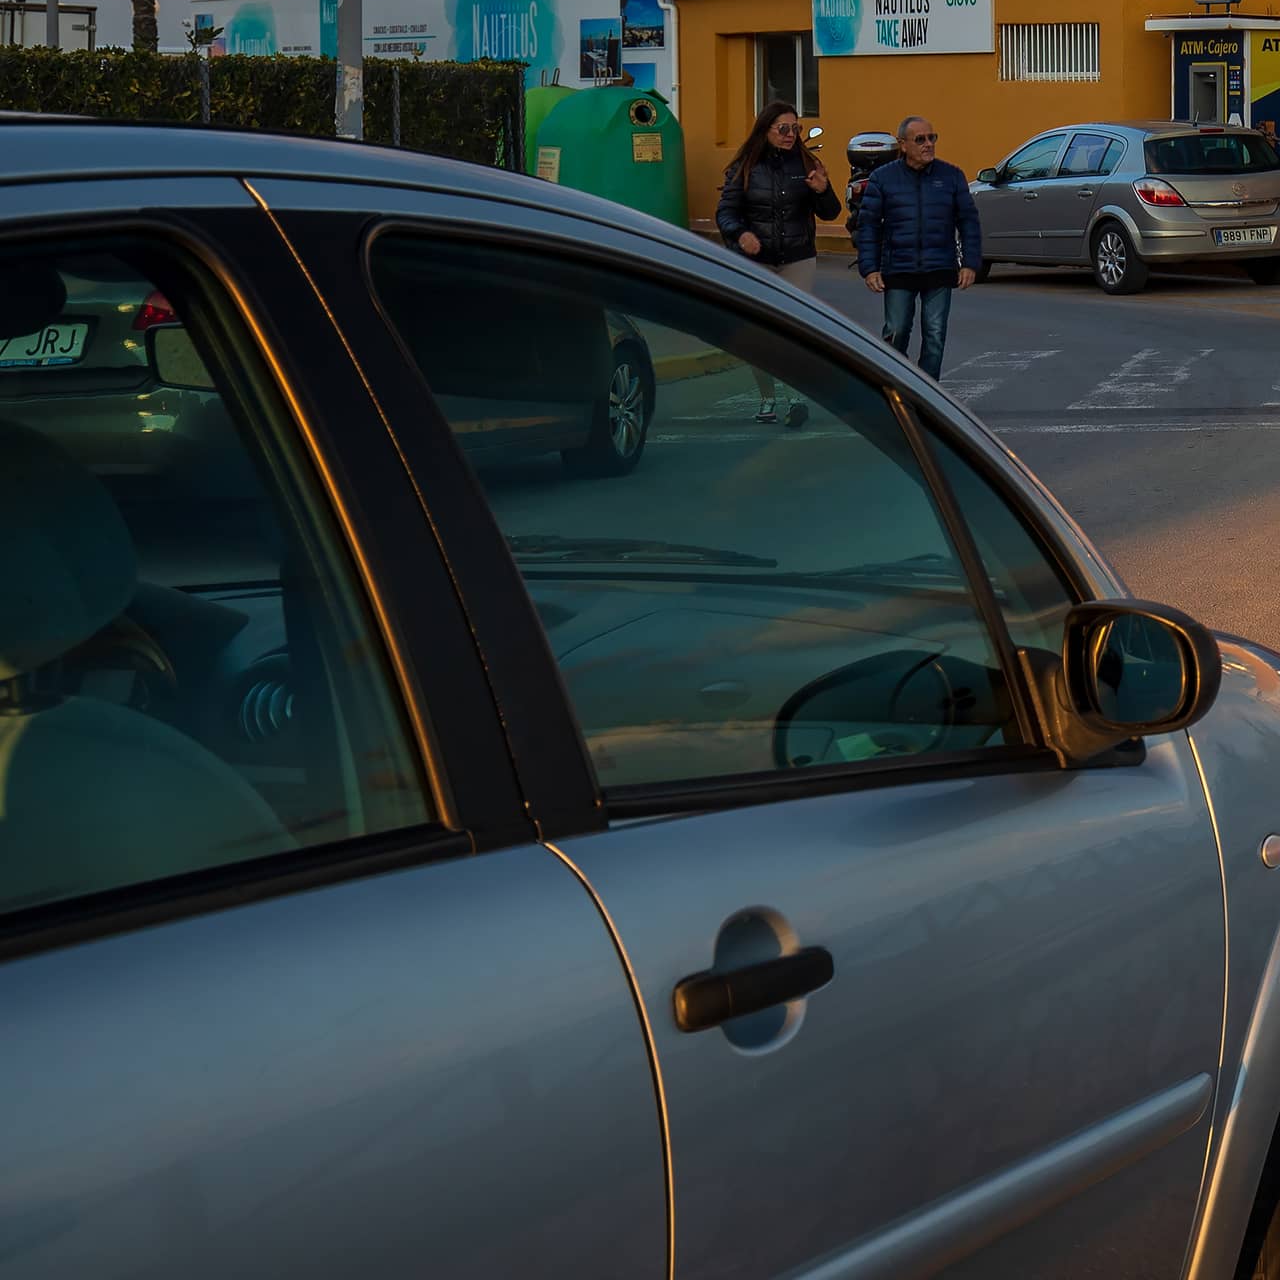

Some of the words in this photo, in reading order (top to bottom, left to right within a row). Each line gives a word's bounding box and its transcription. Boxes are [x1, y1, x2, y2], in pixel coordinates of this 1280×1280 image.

[473, 1, 538, 59] NAUTILUS
[875, 19, 900, 48] TAKE
[901, 18, 929, 48] AWAY
[1223, 230, 1247, 241] 9891
[1250, 228, 1269, 240] FNP
[25, 328, 77, 356] JRJ
